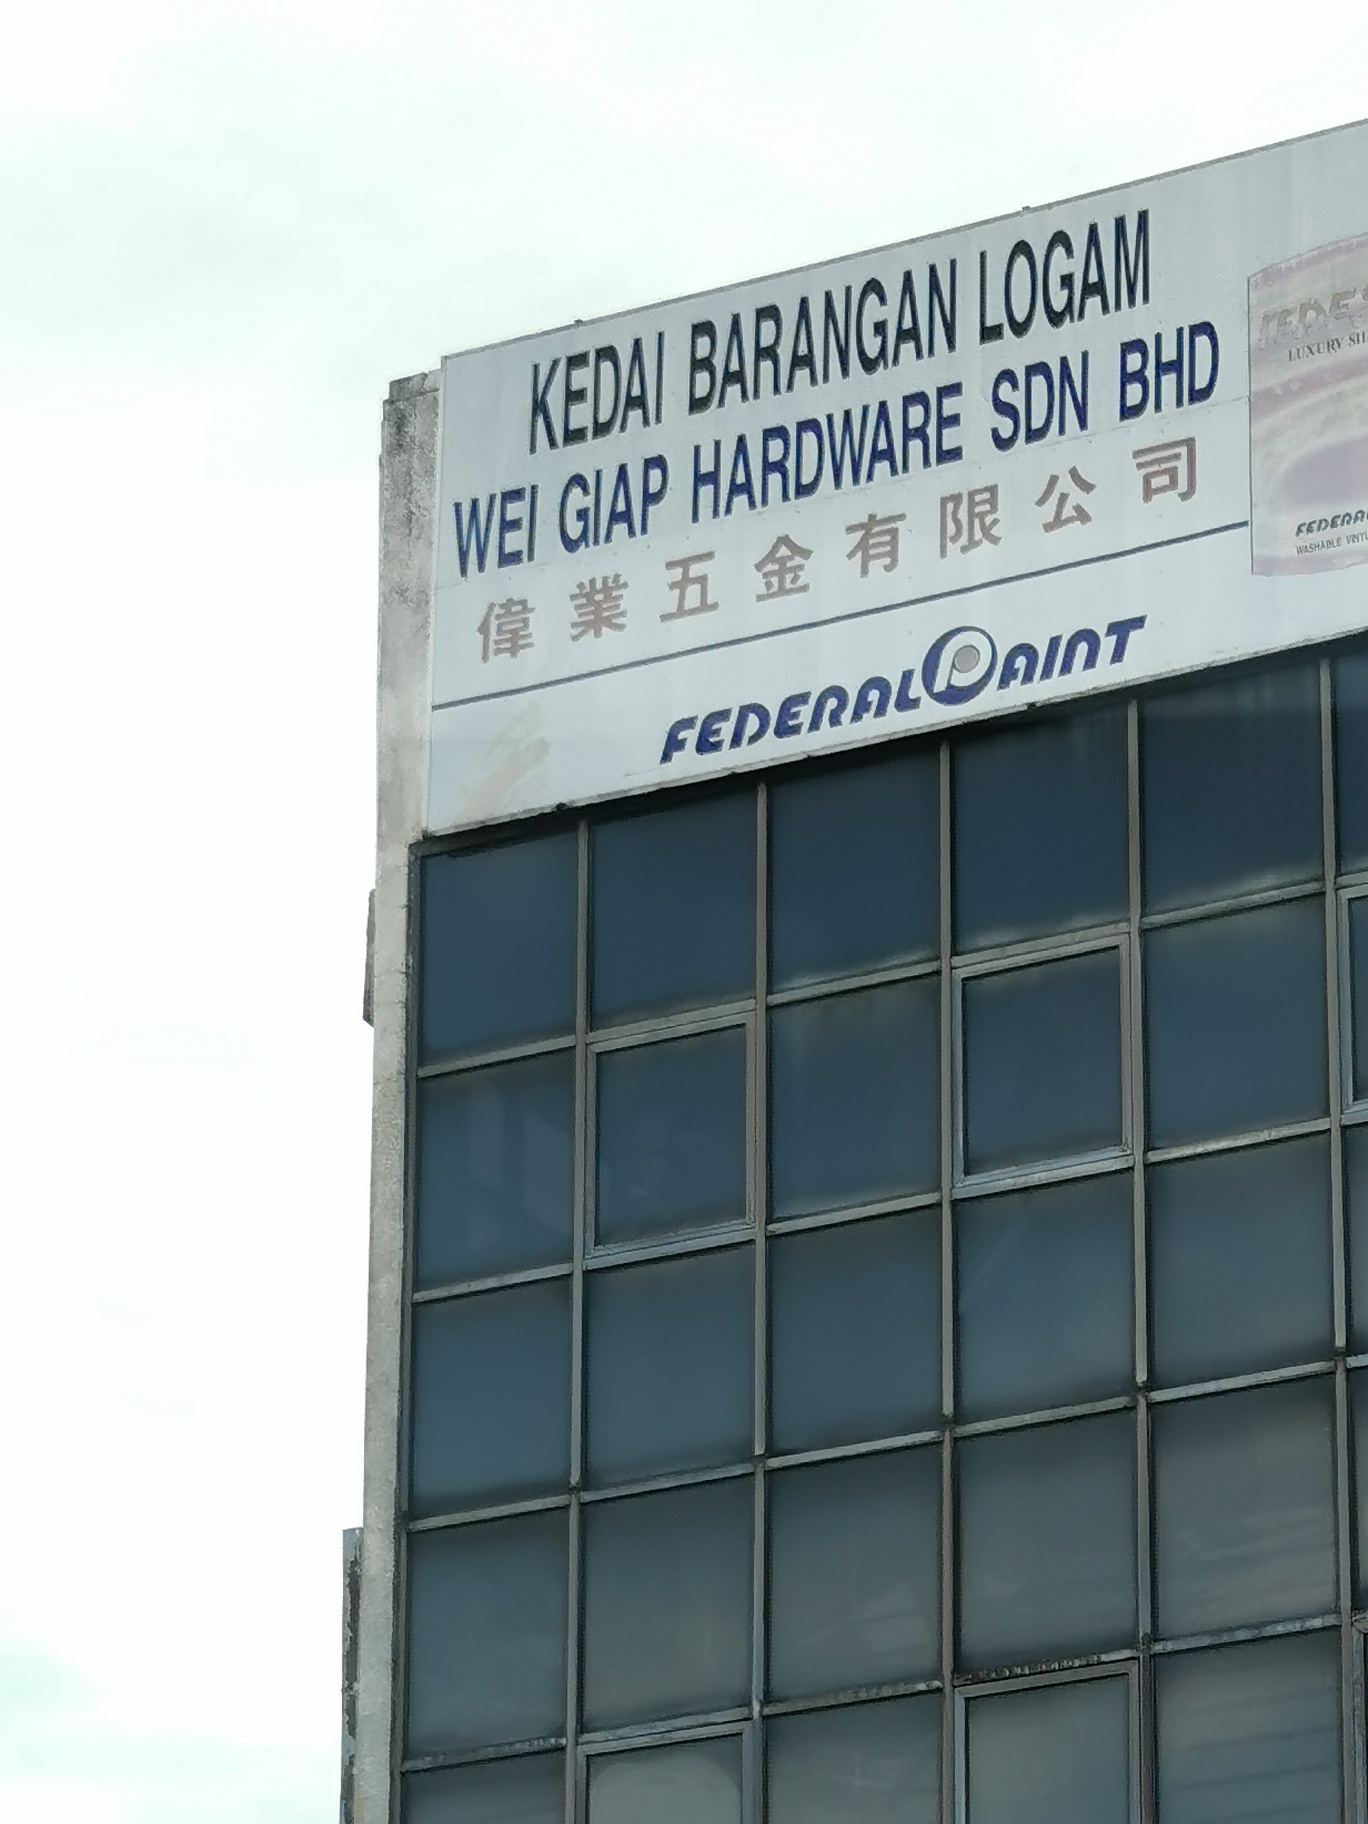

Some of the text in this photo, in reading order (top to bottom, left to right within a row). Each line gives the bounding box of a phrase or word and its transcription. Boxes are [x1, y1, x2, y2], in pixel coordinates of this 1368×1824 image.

[455, 320, 1220, 578] WEI GIAP HARDWARE SDN BHD
[529, 210, 1150, 455] KEDAI BARANGAN LOGAM
[1288, 337, 1343, 362] LUXURY
[477, 437, 1199, 664] 偉業五金有限公司
